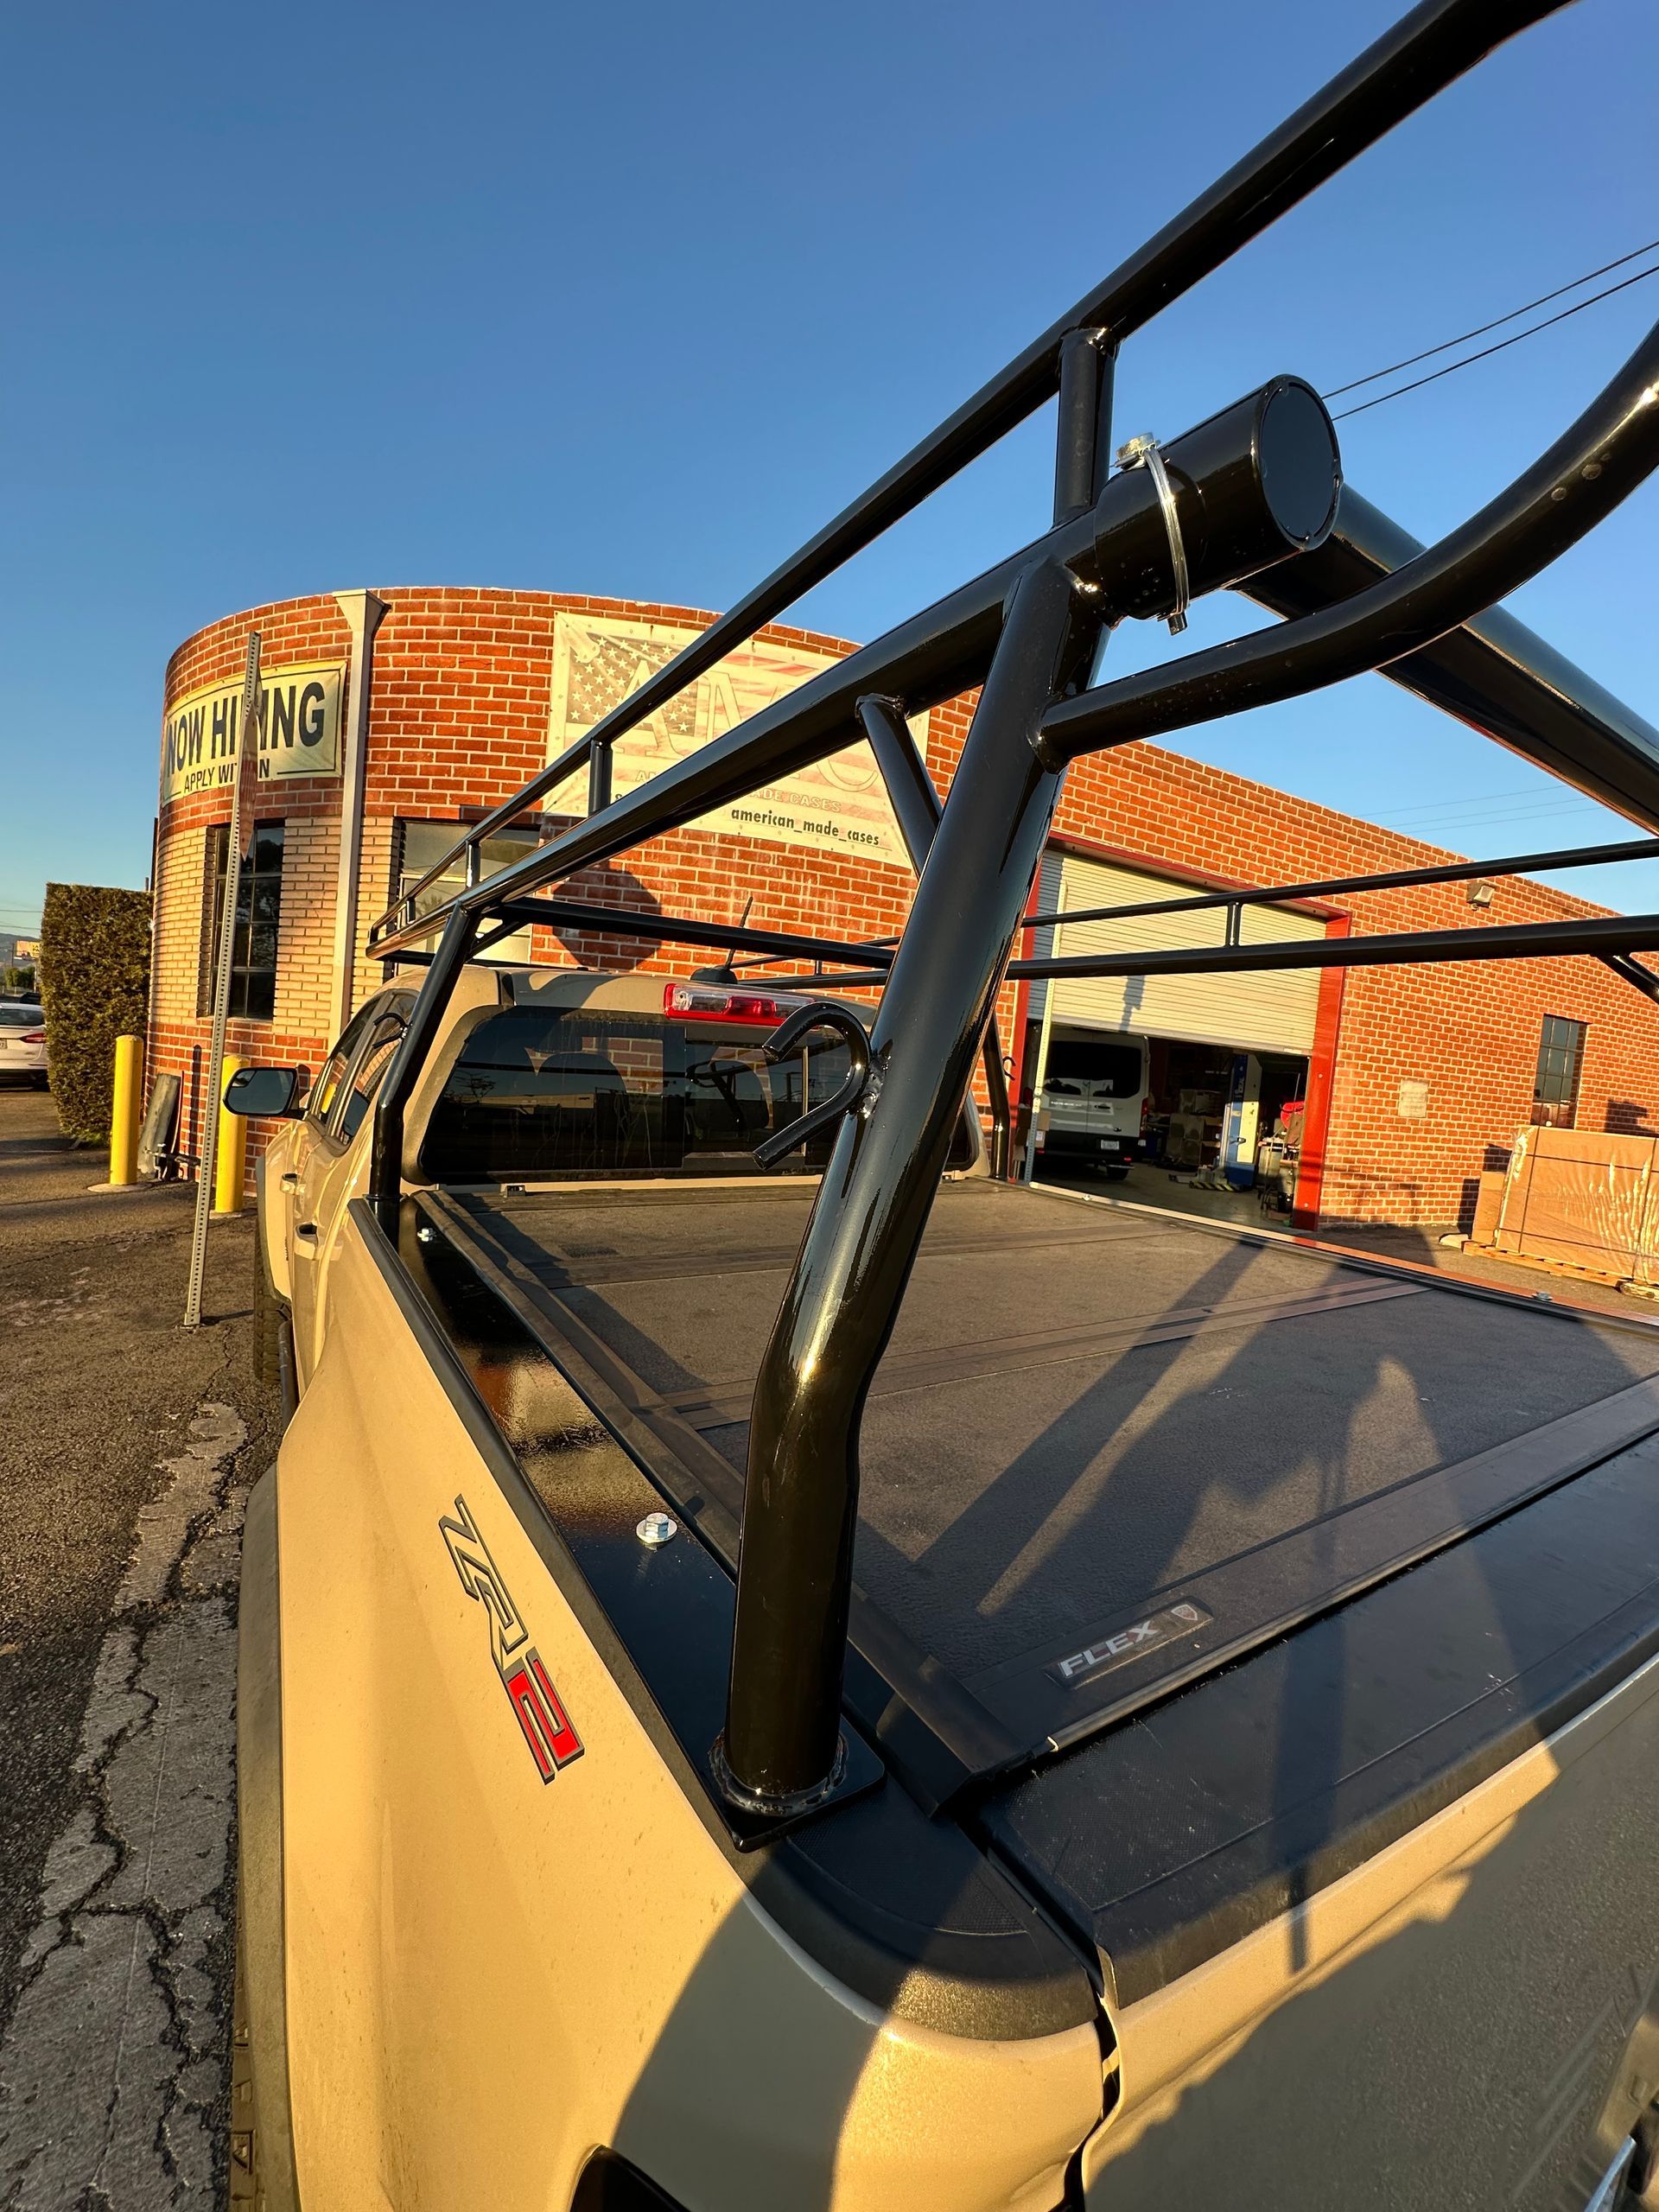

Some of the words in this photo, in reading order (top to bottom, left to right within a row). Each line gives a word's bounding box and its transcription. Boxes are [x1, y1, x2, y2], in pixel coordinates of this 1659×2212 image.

[167, 705, 207, 778] NOW
[211, 682, 326, 760] HIING
[184, 766, 215, 793] APPLY
[218, 759, 270, 785] WIN
[749, 787, 785, 803] ADE
[789, 791, 842, 813] CASES
[731, 809, 880, 846] american_made_cases
[438, 1493, 585, 1785] ZR2
[1058, 1620, 1160, 1678] FLEX
